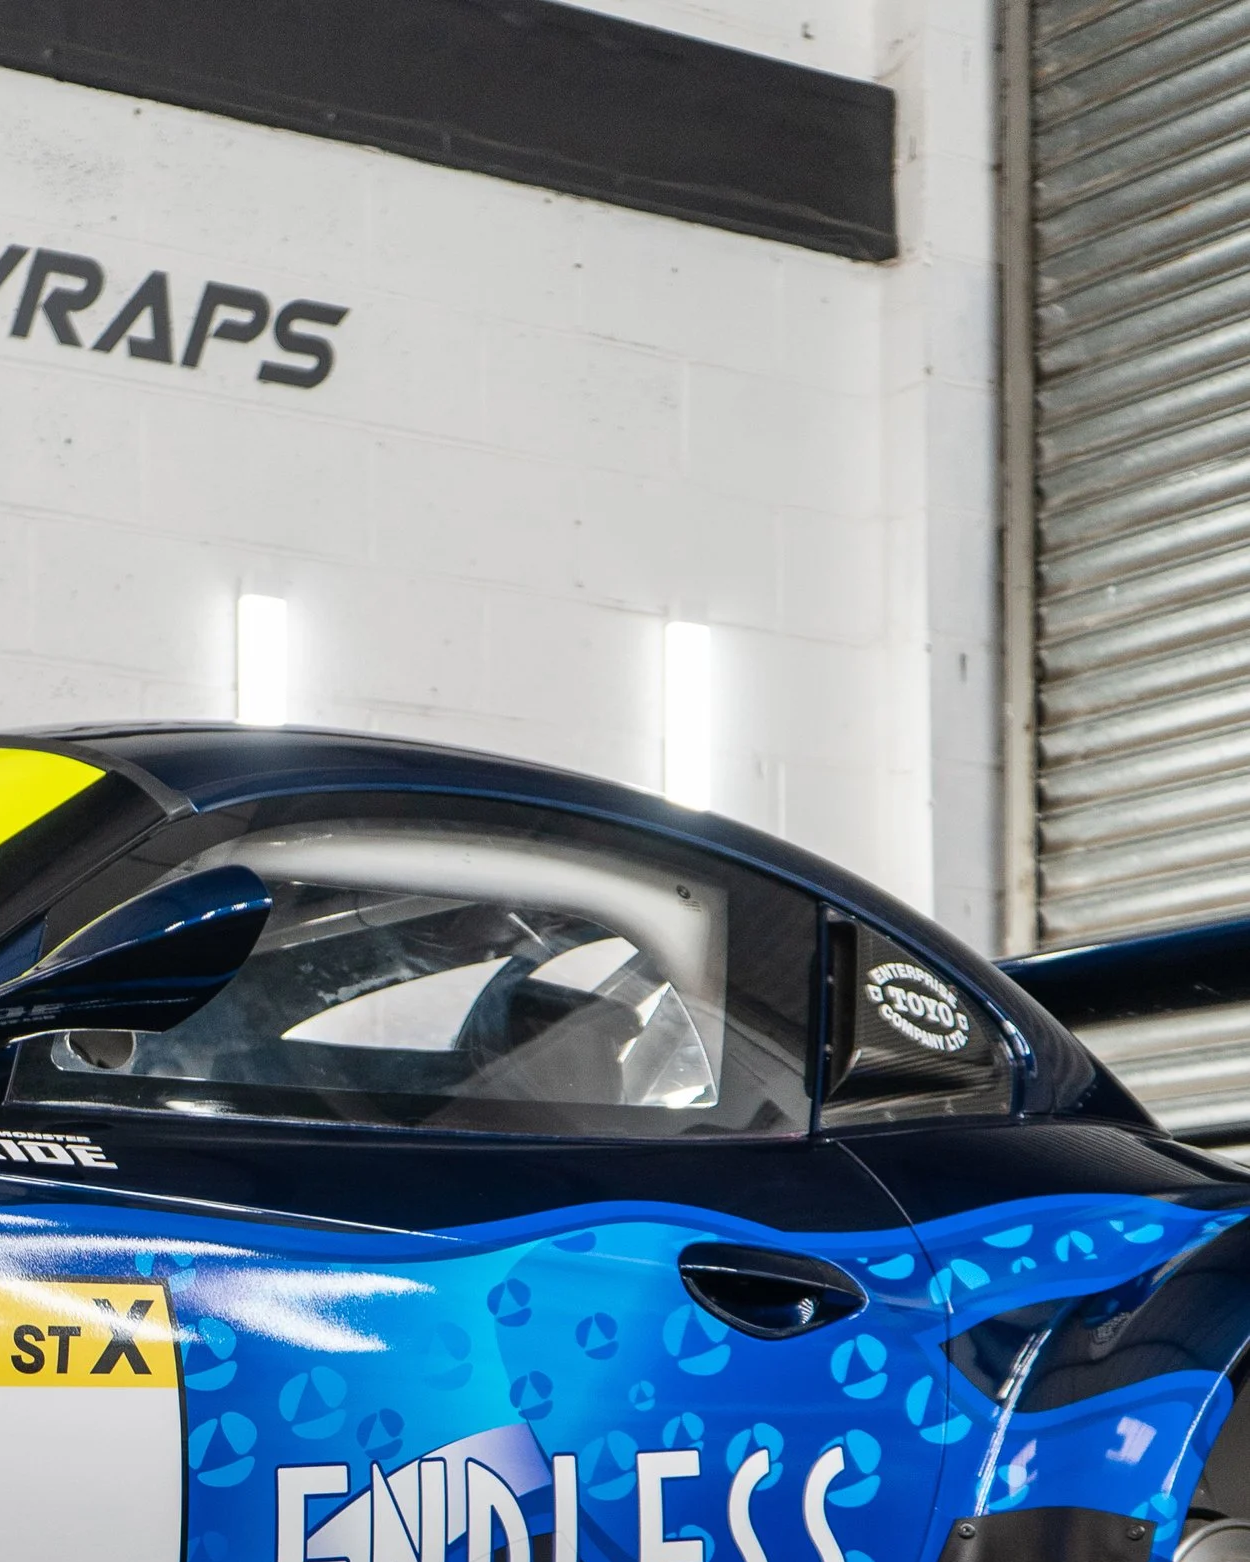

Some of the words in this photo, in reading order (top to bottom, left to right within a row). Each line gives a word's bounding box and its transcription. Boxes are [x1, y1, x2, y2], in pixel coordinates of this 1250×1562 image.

[867, 962, 958, 1009] ENTERPRISE
[884, 985, 955, 1029] TOYO
[878, 1003, 946, 1050] COMPANY
